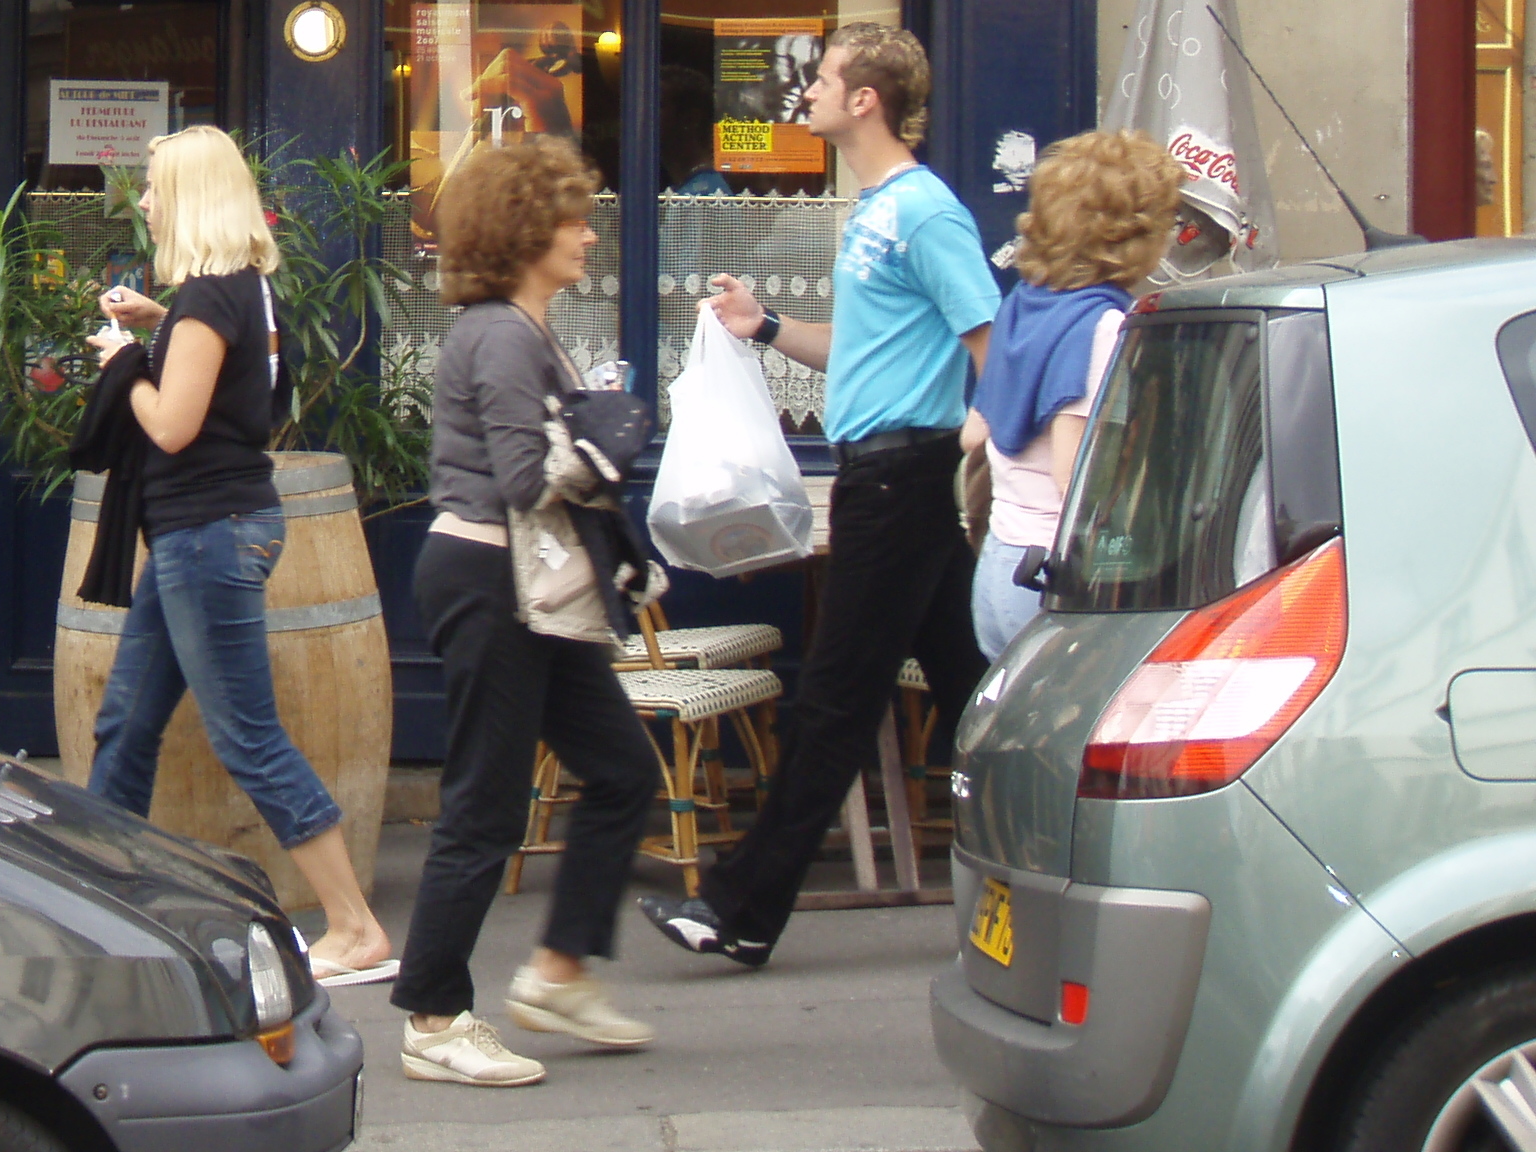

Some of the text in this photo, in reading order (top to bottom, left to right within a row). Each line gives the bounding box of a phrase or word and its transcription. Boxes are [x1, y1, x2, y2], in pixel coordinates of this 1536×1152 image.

[722, 125, 770, 134] METHOD
[722, 134, 764, 142] ACTING
[722, 142, 767, 151] CENTER
